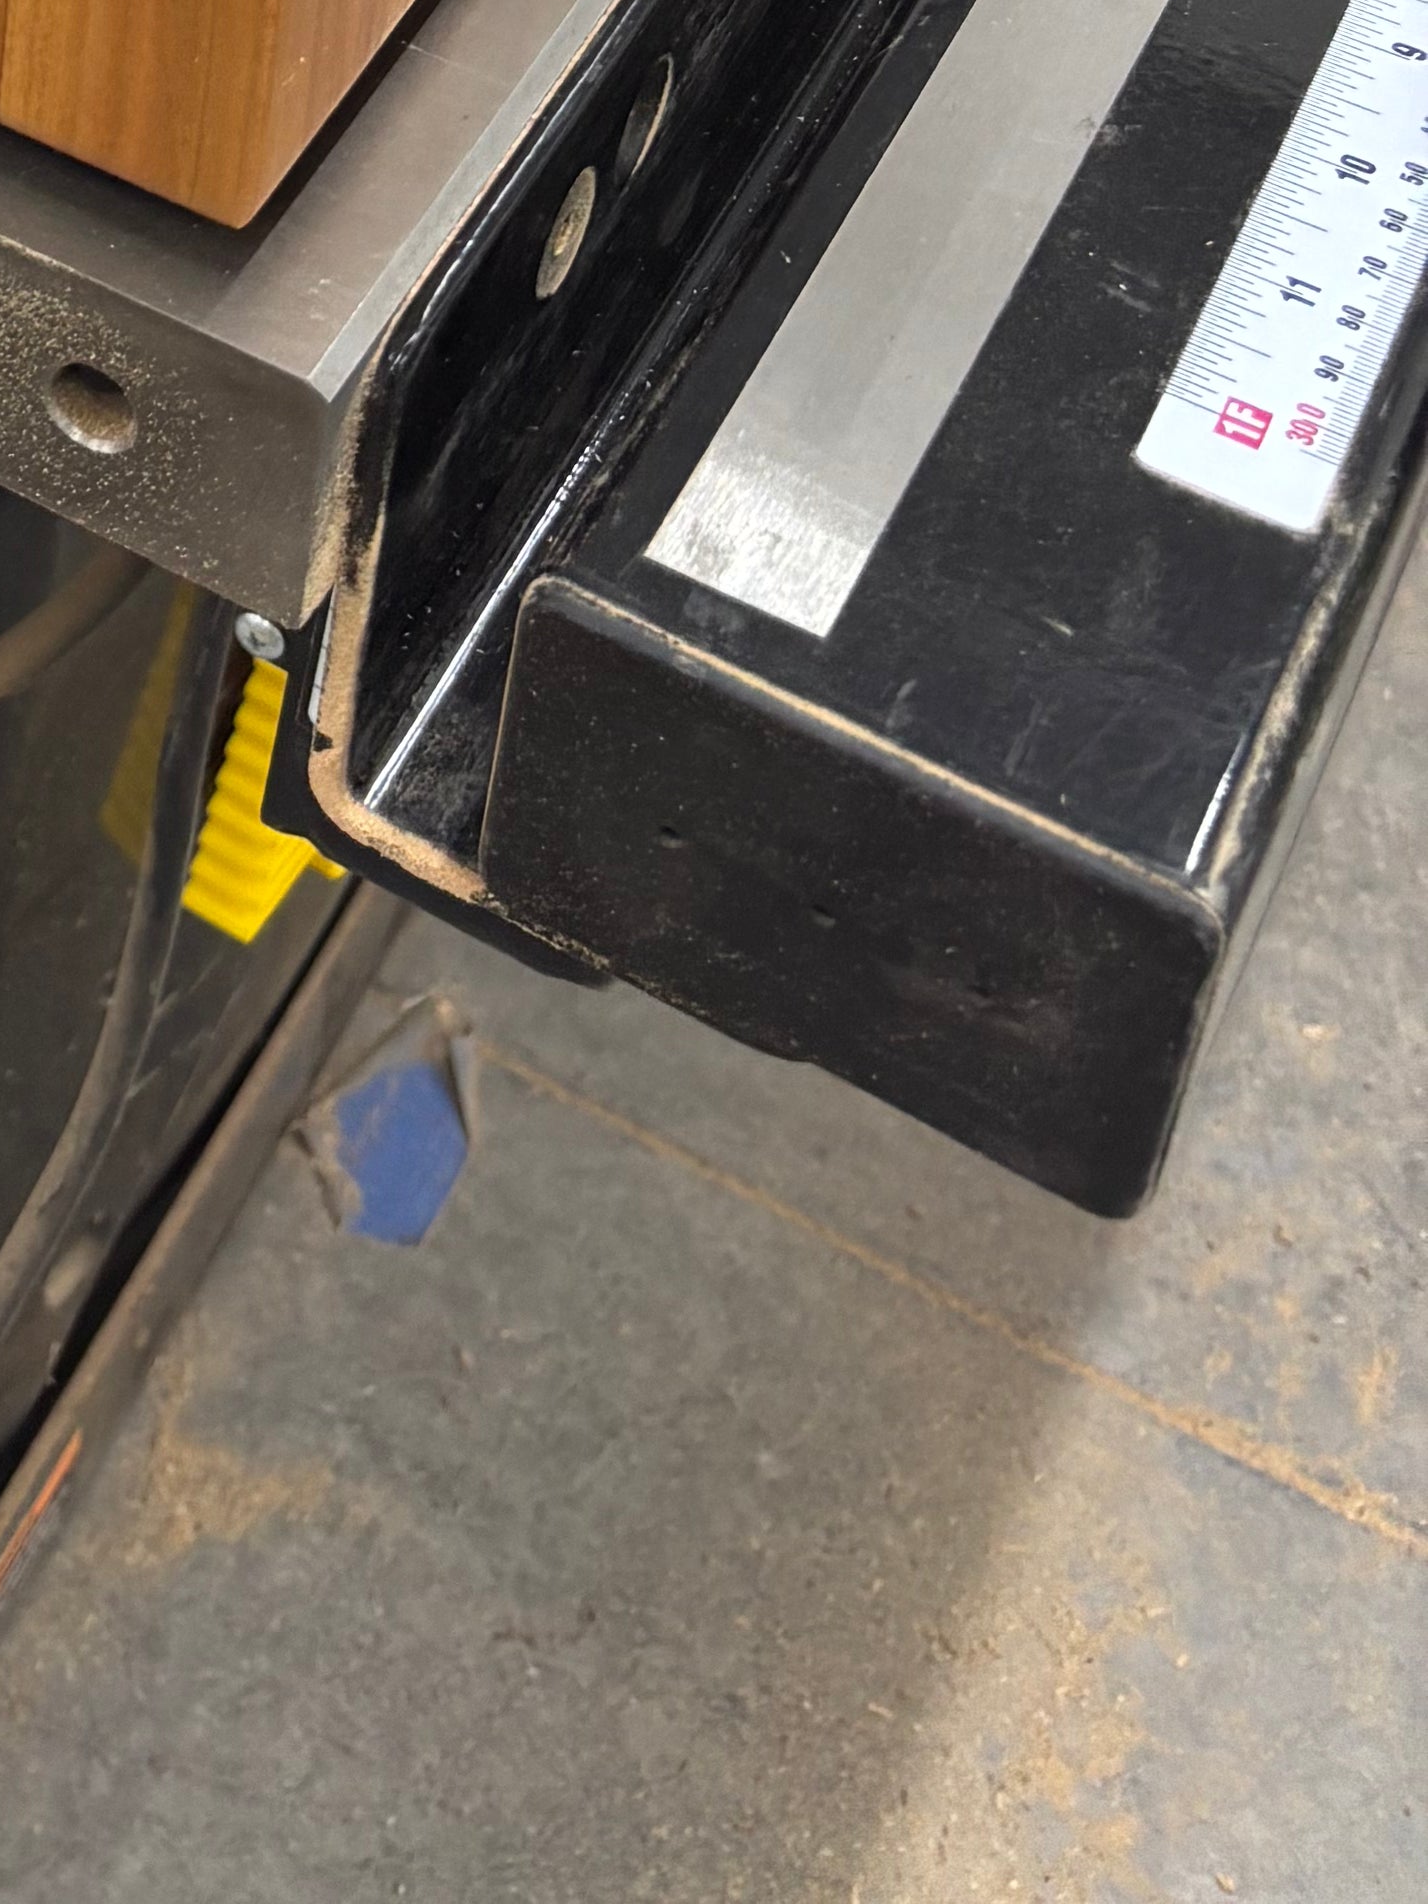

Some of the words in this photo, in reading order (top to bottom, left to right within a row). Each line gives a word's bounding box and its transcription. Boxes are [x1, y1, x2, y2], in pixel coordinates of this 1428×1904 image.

[1391, 41, 1428, 61] 9
[1334, 153, 1377, 185] 10
[1399, 160, 1428, 186] 50
[1378, 207, 1408, 233] 60
[1357, 255, 1388, 281] 70
[1279, 275, 1323, 308] 11
[1335, 304, 1366, 331] 80
[1313, 354, 1345, 383] 90
[1218, 399, 1268, 442] 1F
[1284, 402, 1327, 446] 300
